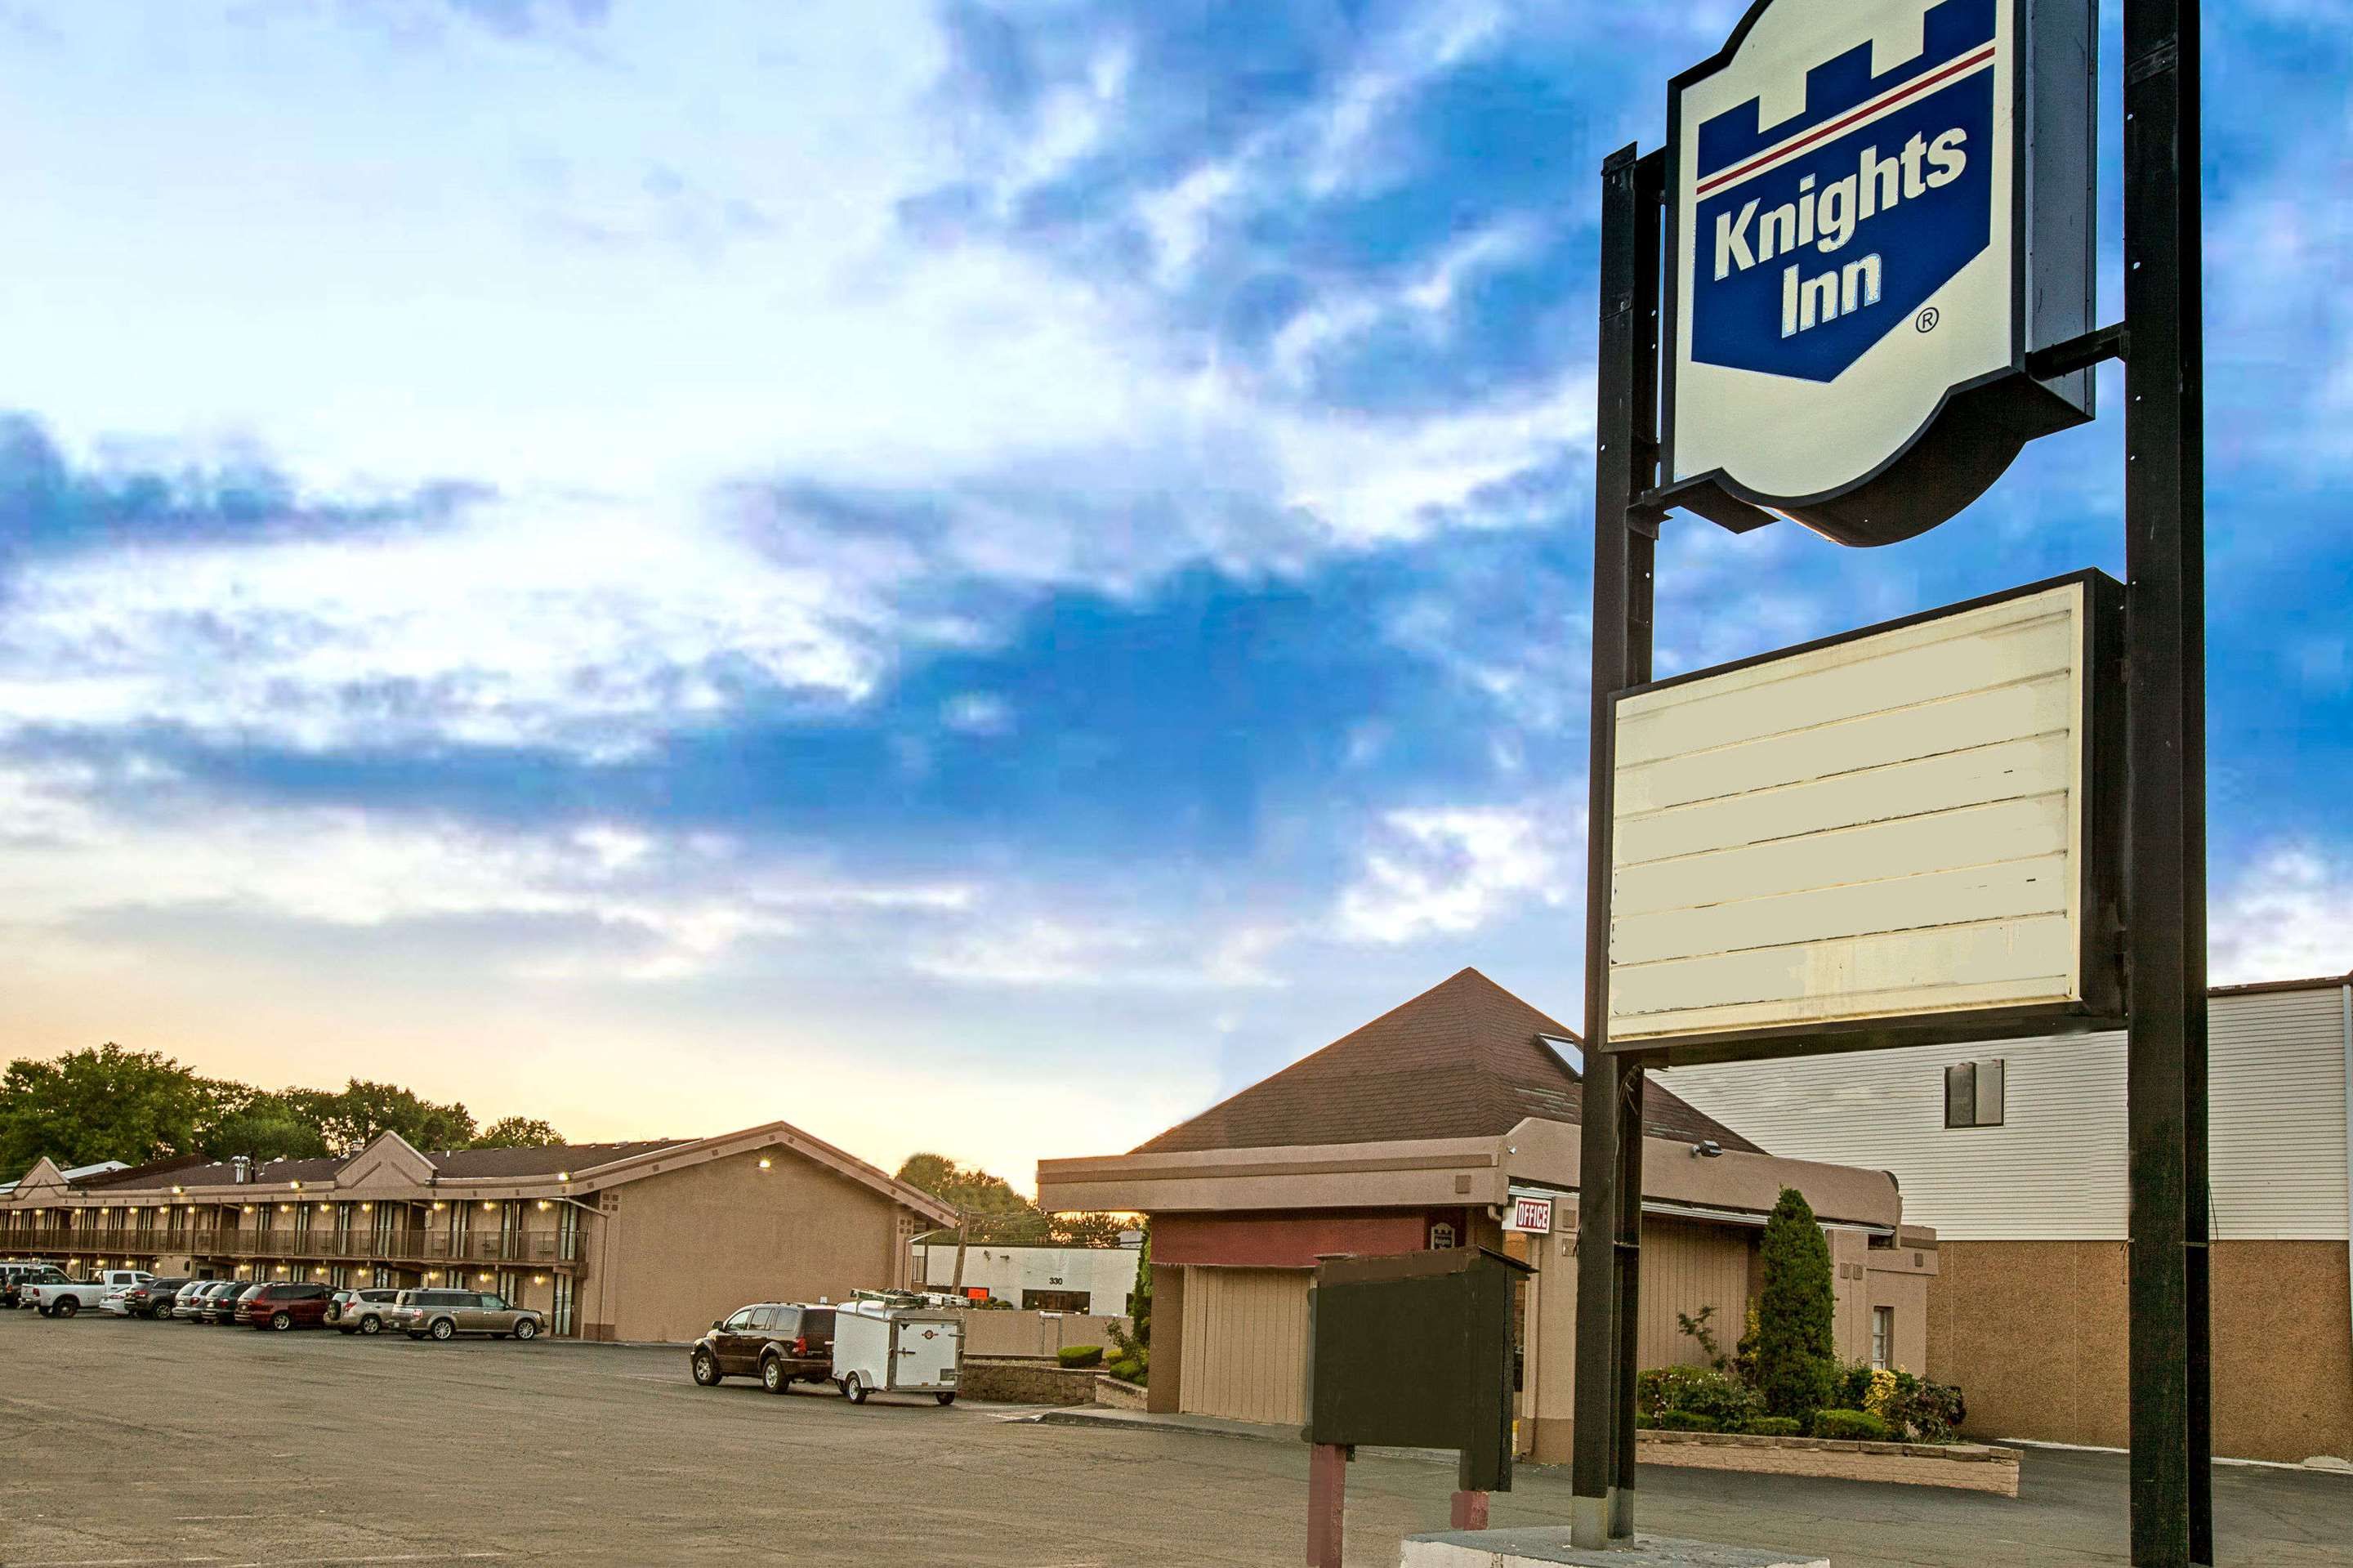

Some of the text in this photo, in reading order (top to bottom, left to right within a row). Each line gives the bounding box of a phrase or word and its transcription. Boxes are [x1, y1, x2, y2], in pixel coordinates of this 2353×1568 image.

[1714, 127, 1967, 281] Knights
[1781, 252, 1882, 338] Inn
[1518, 1204, 1548, 1228] OFFICE
